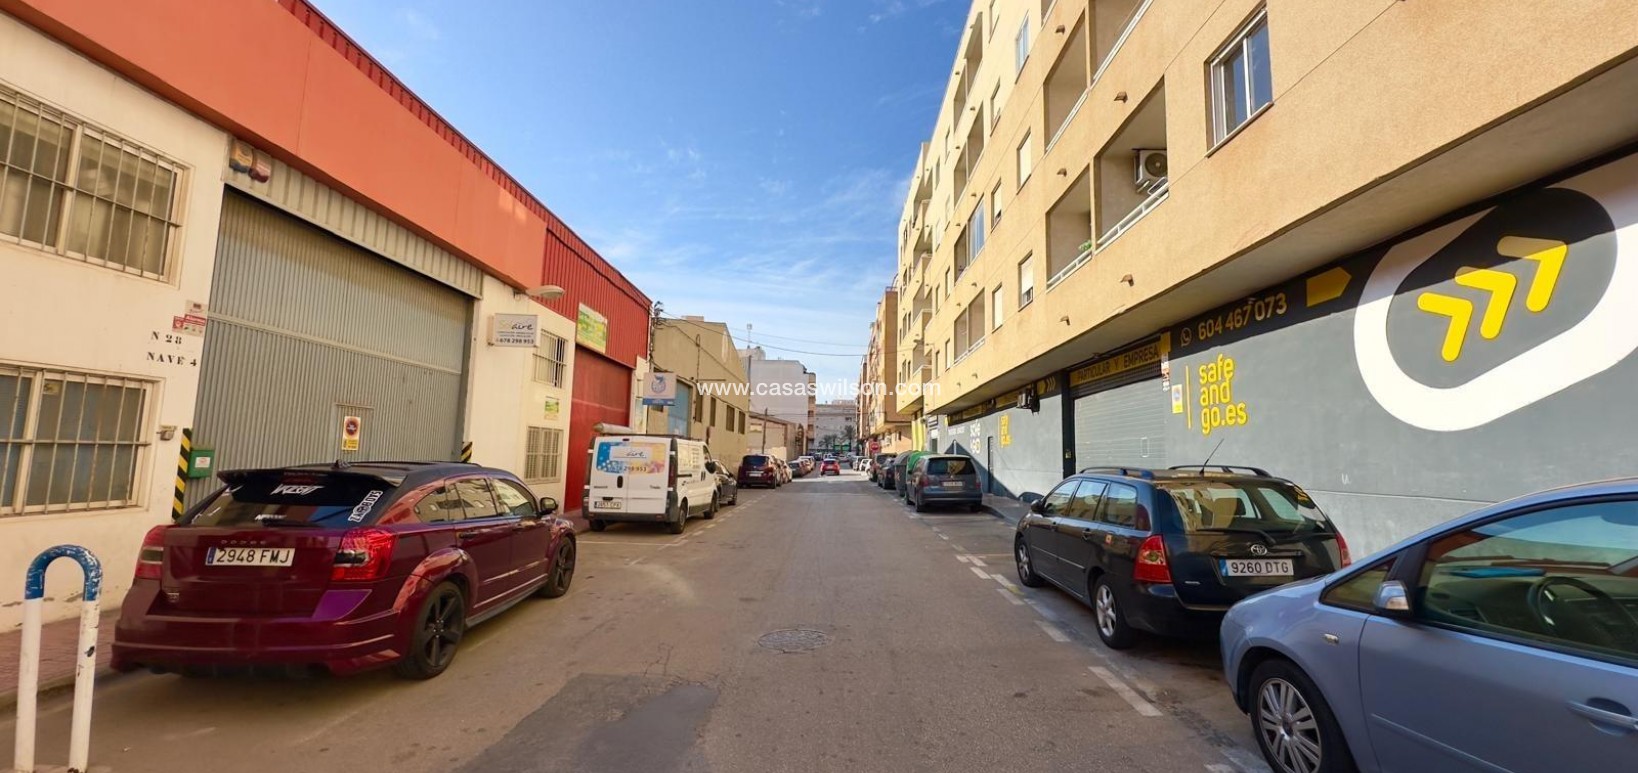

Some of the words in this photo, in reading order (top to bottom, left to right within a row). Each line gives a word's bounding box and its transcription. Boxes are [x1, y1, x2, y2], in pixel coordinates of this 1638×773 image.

[511, 323, 534, 331] aire
[1198, 315, 1223, 341] 604
[1225, 307, 1250, 332] 467
[1254, 293, 1287, 321] 073
[151, 331, 160, 340] N
[166, 334, 182, 344] 28
[147, 352, 185, 365] NAVE
[1114, 359, 1119, 370] Y
[1124, 345, 1159, 368] EMPRESA
[1199, 354, 1235, 384] safe
[1200, 379, 1231, 407] and
[1201, 401, 1247, 435] go.es
[216, 549, 255, 563] 2948
[260, 549, 290, 564] FMJ
[1231, 561, 1262, 573] 9260
[1266, 561, 1289, 573] DTG
